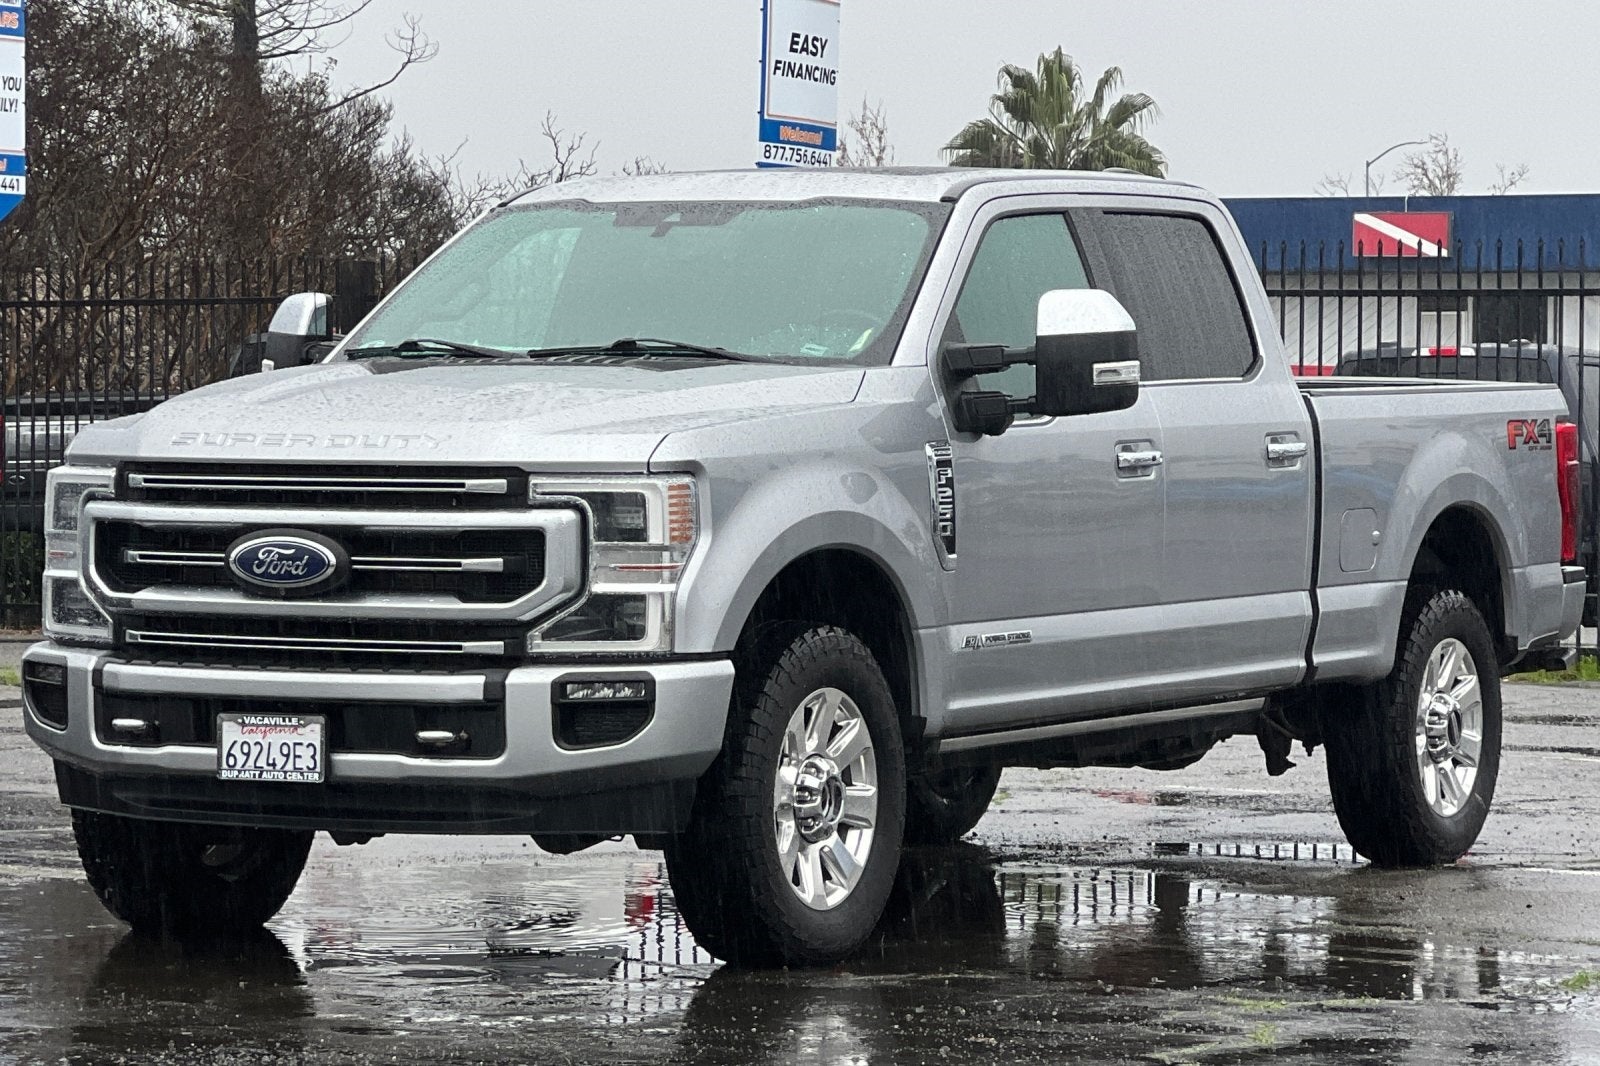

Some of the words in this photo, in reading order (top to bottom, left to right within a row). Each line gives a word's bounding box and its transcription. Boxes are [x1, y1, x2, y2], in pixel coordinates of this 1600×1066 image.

[789, 32, 828, 58] EASY
[773, 59, 836, 86] FINANCING
[2, 76, 22, 91] YOU
[780, 125, 823, 145] Welcome!
[764, 144, 832, 167] 877.756.6441
[170, 432, 316, 448] SUPER
[324, 433, 452, 449] DUTY
[1507, 419, 1552, 450] FX4
[252, 546, 310, 576] Ford
[243, 716, 299, 726] VACAVILLE
[240, 725, 304, 740] California
[225, 740, 317, 770] 69249E3
[262, 770, 284, 779] AUTO
